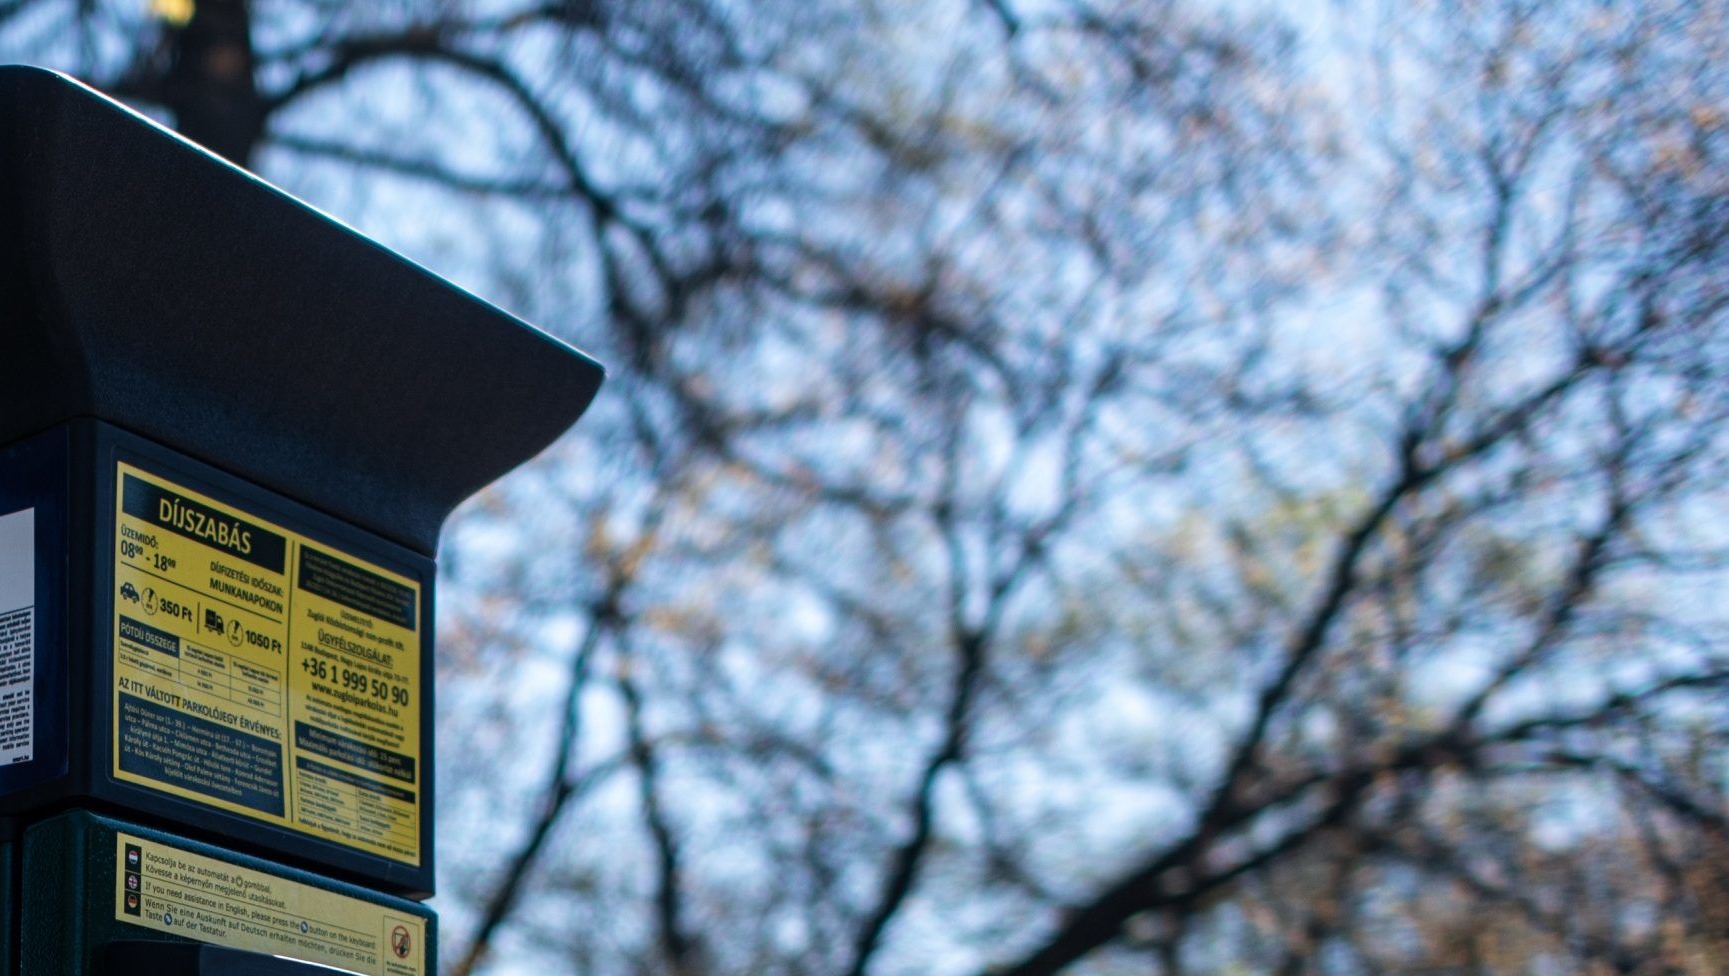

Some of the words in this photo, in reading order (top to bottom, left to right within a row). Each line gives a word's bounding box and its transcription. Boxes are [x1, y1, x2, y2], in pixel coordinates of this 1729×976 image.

[160, 498, 250, 554] DÍJSZABÁS
[160, 599, 179, 617] 350
[182, 607, 192, 622] Ft
[210, 578, 282, 614] MUNKANAPOKON
[246, 630, 269, 649] 1050
[272, 639, 281, 654] Ft
[318, 629, 393, 666] ÜGYFÉLSZOLGÁLAT:
[302, 658, 326, 679] +36
[331, 666, 338, 684] 1
[343, 669, 367, 693] 999
[372, 679, 388, 700] 50
[392, 686, 408, 706] 90
[119, 677, 129, 689] AZ
[131, 681, 143, 693] ITT
[145, 686, 180, 707] VÁLTOTT
[182, 698, 237, 725] PARKOLÓJEGY
[240, 715, 281, 739] ÉRVÉNYES:
[146, 852, 176, 868] Kapcsolja
[178, 862, 184, 870] be
[197, 868, 228, 882] automatát
[146, 864, 172, 878] Kövesse
[180, 873, 212, 889] képernyőn
[215, 884, 246, 898] megjelenő
[145, 909, 162, 921] Taste
[174, 918, 184, 926] auf
[186, 921, 197, 929] der
[199, 923, 225, 937] Tastatur.
[146, 881, 151, 890] If
[153, 885, 164, 894] you
[167, 889, 182, 899] need
[184, 893, 215, 908] assistance
[226, 903, 249, 918] English,
[251, 911, 270, 922] please
[272, 917, 288, 927] press
[290, 921, 300, 929] the
[309, 926, 328, 936] button
[338, 933, 348, 942] the
[145, 899, 164, 910] Wenn
[167, 904, 177, 914] Sie
[180, 909, 194, 918] eine
[196, 912, 226, 927] Auskunft
[229, 921, 239, 929] auf
[241, 923, 267, 937] Deutsch
[269, 932, 296, 944] erhalten
[355, 953, 364, 962] Sie
